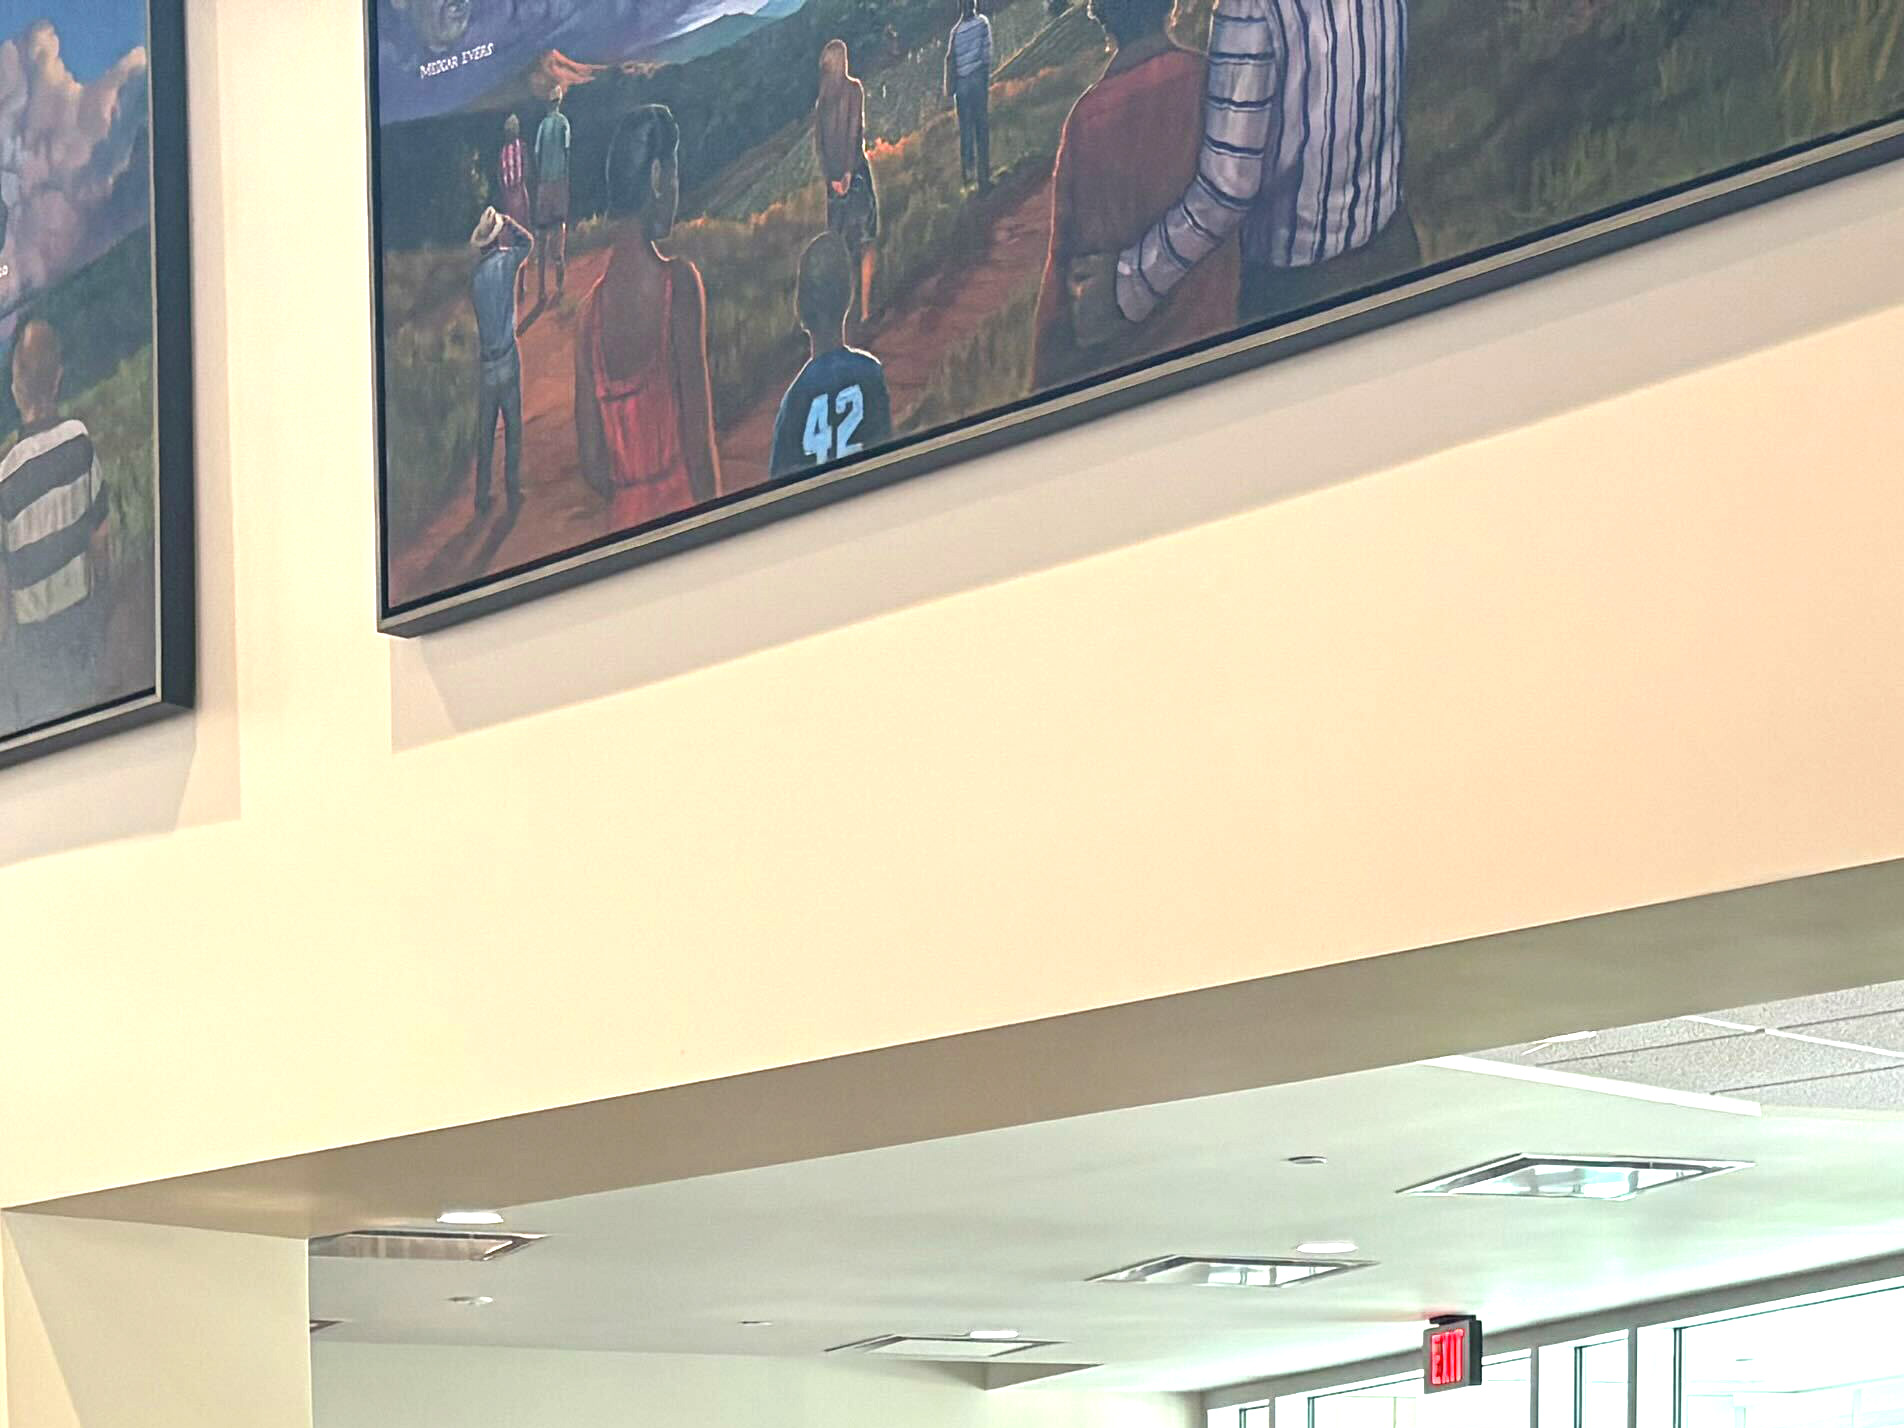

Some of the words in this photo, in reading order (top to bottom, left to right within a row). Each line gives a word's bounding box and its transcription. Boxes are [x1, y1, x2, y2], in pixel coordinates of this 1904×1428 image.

[420, 55, 458, 80] MEDGAR
[461, 42, 494, 64] EVERS
[804, 384, 865, 465] 42
[1431, 1328, 1464, 1385] EXIT
